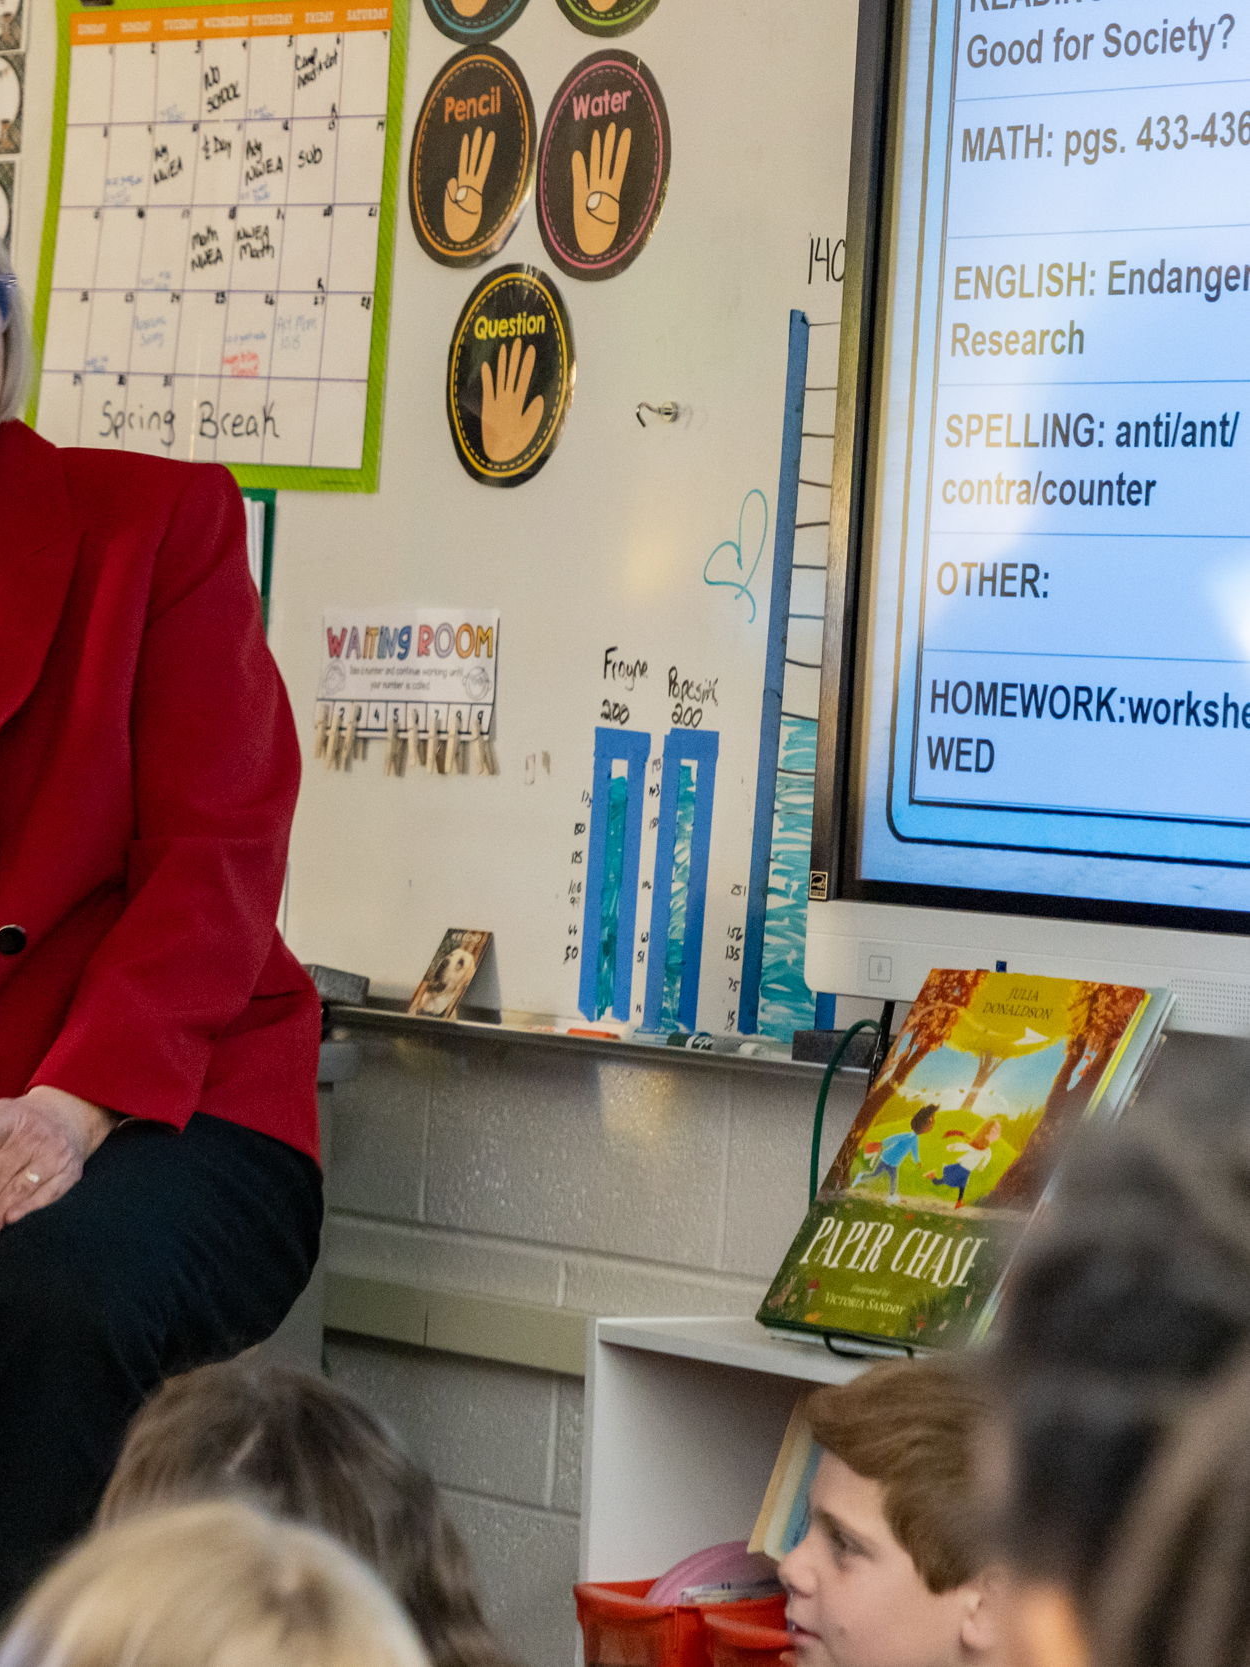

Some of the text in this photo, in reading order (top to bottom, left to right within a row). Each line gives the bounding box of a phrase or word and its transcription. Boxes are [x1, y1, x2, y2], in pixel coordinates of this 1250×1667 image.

[304, 11, 335, 24] FRIDAY
[346, 8, 388, 21] SATURDAY
[966, 13, 1236, 68] Good for Society?
[443, 86, 501, 124] Pencil
[572, 89, 631, 121] Water
[961, 110, 1250, 166] MATH: pgs. 433-436
[245, 156, 284, 186] NWEA
[953, 262, 1097, 300] ENGLISH:
[474, 311, 546, 341] Question
[951, 320, 1085, 357] Research
[100, 400, 279, 447] Spring Break
[944, 410, 1240, 448] SPELLING: anti/ant/
[942, 471, 1157, 507] contra/counter
[936, 562, 1050, 598] OTHER:
[417, 622, 493, 659] ROOM
[383, 681, 403, 690] number
[396, 666, 420, 676] continue
[422, 667, 447, 679] working
[374, 708, 380, 723] 4
[926, 735, 996, 774] WED
[730, 884, 747, 897] 251
[563, 945, 579, 964] 50
[725, 945, 741, 961] 135
[728, 977, 741, 992] 75
[1009, 988, 1040, 1002] JULIA
[982, 1002, 1054, 1020] DONALDSON
[798, 1216, 989, 1289] PAPER CHASE
